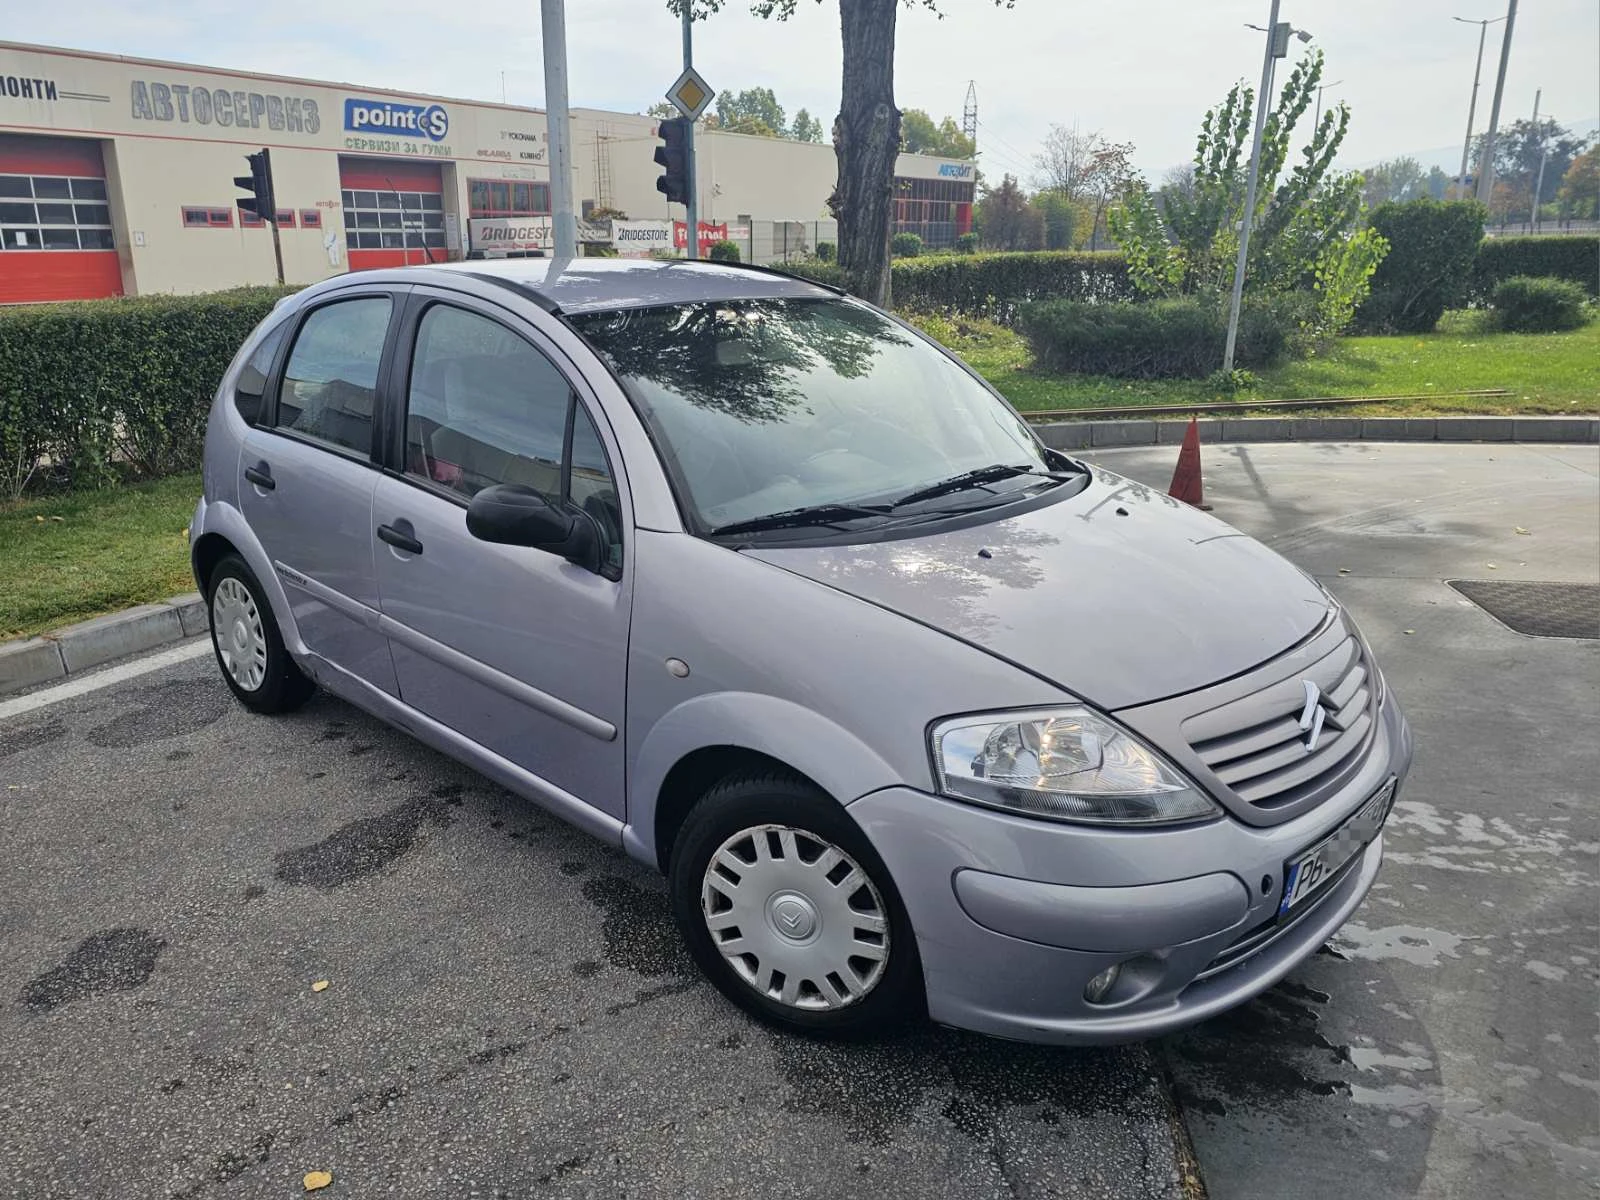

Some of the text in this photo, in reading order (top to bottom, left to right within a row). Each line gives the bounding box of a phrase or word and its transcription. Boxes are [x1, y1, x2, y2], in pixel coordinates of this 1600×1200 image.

[131, 80, 320, 134] АВТОСЕРВИЗ
[352, 104, 447, 136] point S
[345, 138, 452, 156] СЕРВИЗИ ЗА ГУМИ
[481, 227, 553, 241] BRIDGEST
[618, 228, 669, 241] BRIDGESTONE
